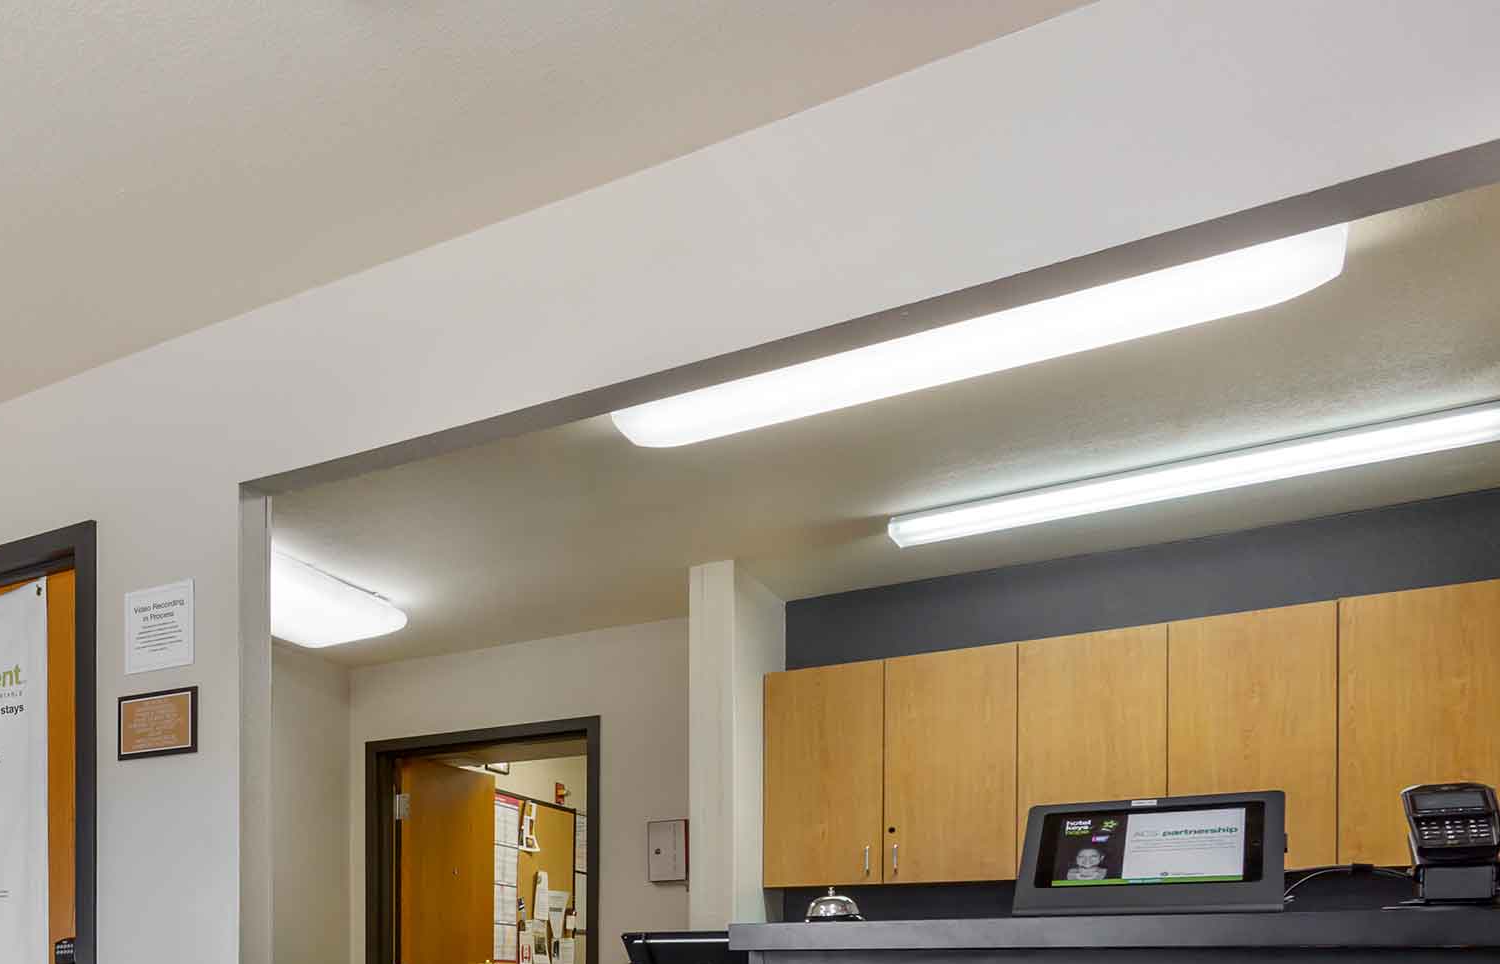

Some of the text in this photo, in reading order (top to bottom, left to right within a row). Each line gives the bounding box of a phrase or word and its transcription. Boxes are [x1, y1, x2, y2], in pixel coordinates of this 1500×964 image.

[133, 598, 185, 614] Video Recording
[150, 611, 174, 621] Process
[0, 703, 24, 716] stays
[1162, 826, 1238, 837] partnership
